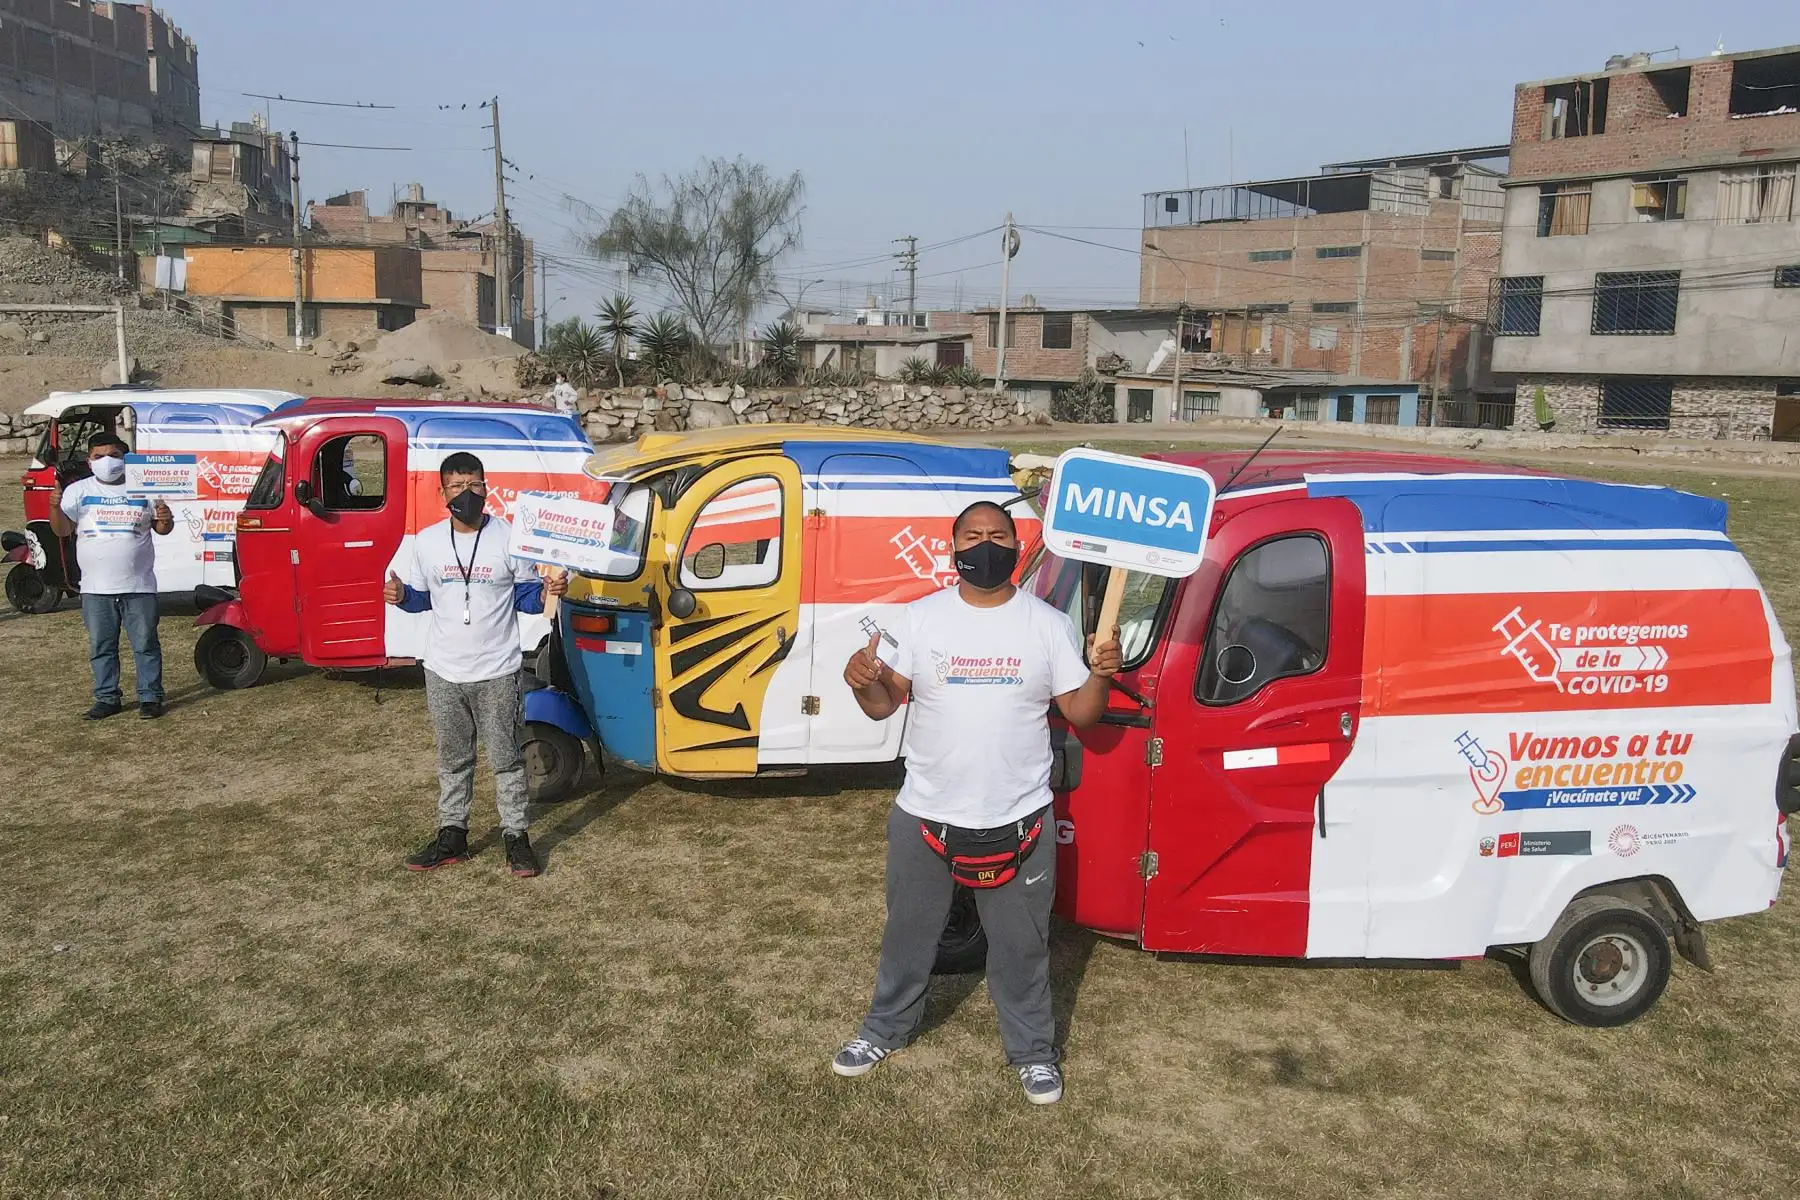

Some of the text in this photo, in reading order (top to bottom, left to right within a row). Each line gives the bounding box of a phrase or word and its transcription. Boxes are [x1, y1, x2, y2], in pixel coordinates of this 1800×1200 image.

[146, 455, 176, 463] MINSA
[231, 475, 240, 483] de
[503, 488, 514, 497] Te
[134, 511, 143, 519] tu
[203, 508, 235, 521] Vam
[1064, 483, 1194, 532] MINSA
[538, 508, 579, 525] Vamos
[591, 520, 606, 530] tu
[538, 522, 602, 539] encuentro
[930, 538, 946, 550] Te
[1549, 624, 1688, 646] Te protegemos
[951, 656, 1021, 667] Vamos a tu
[1576, 650, 1622, 668] de la
[952, 667, 1019, 677] encuentro
[1567, 674, 1669, 694] COVID-19
[1509, 730, 1693, 761] Vamos a tu
[1515, 759, 1684, 789] encuentro
[1546, 789, 1642, 806] ¡Vacúnate ya!
